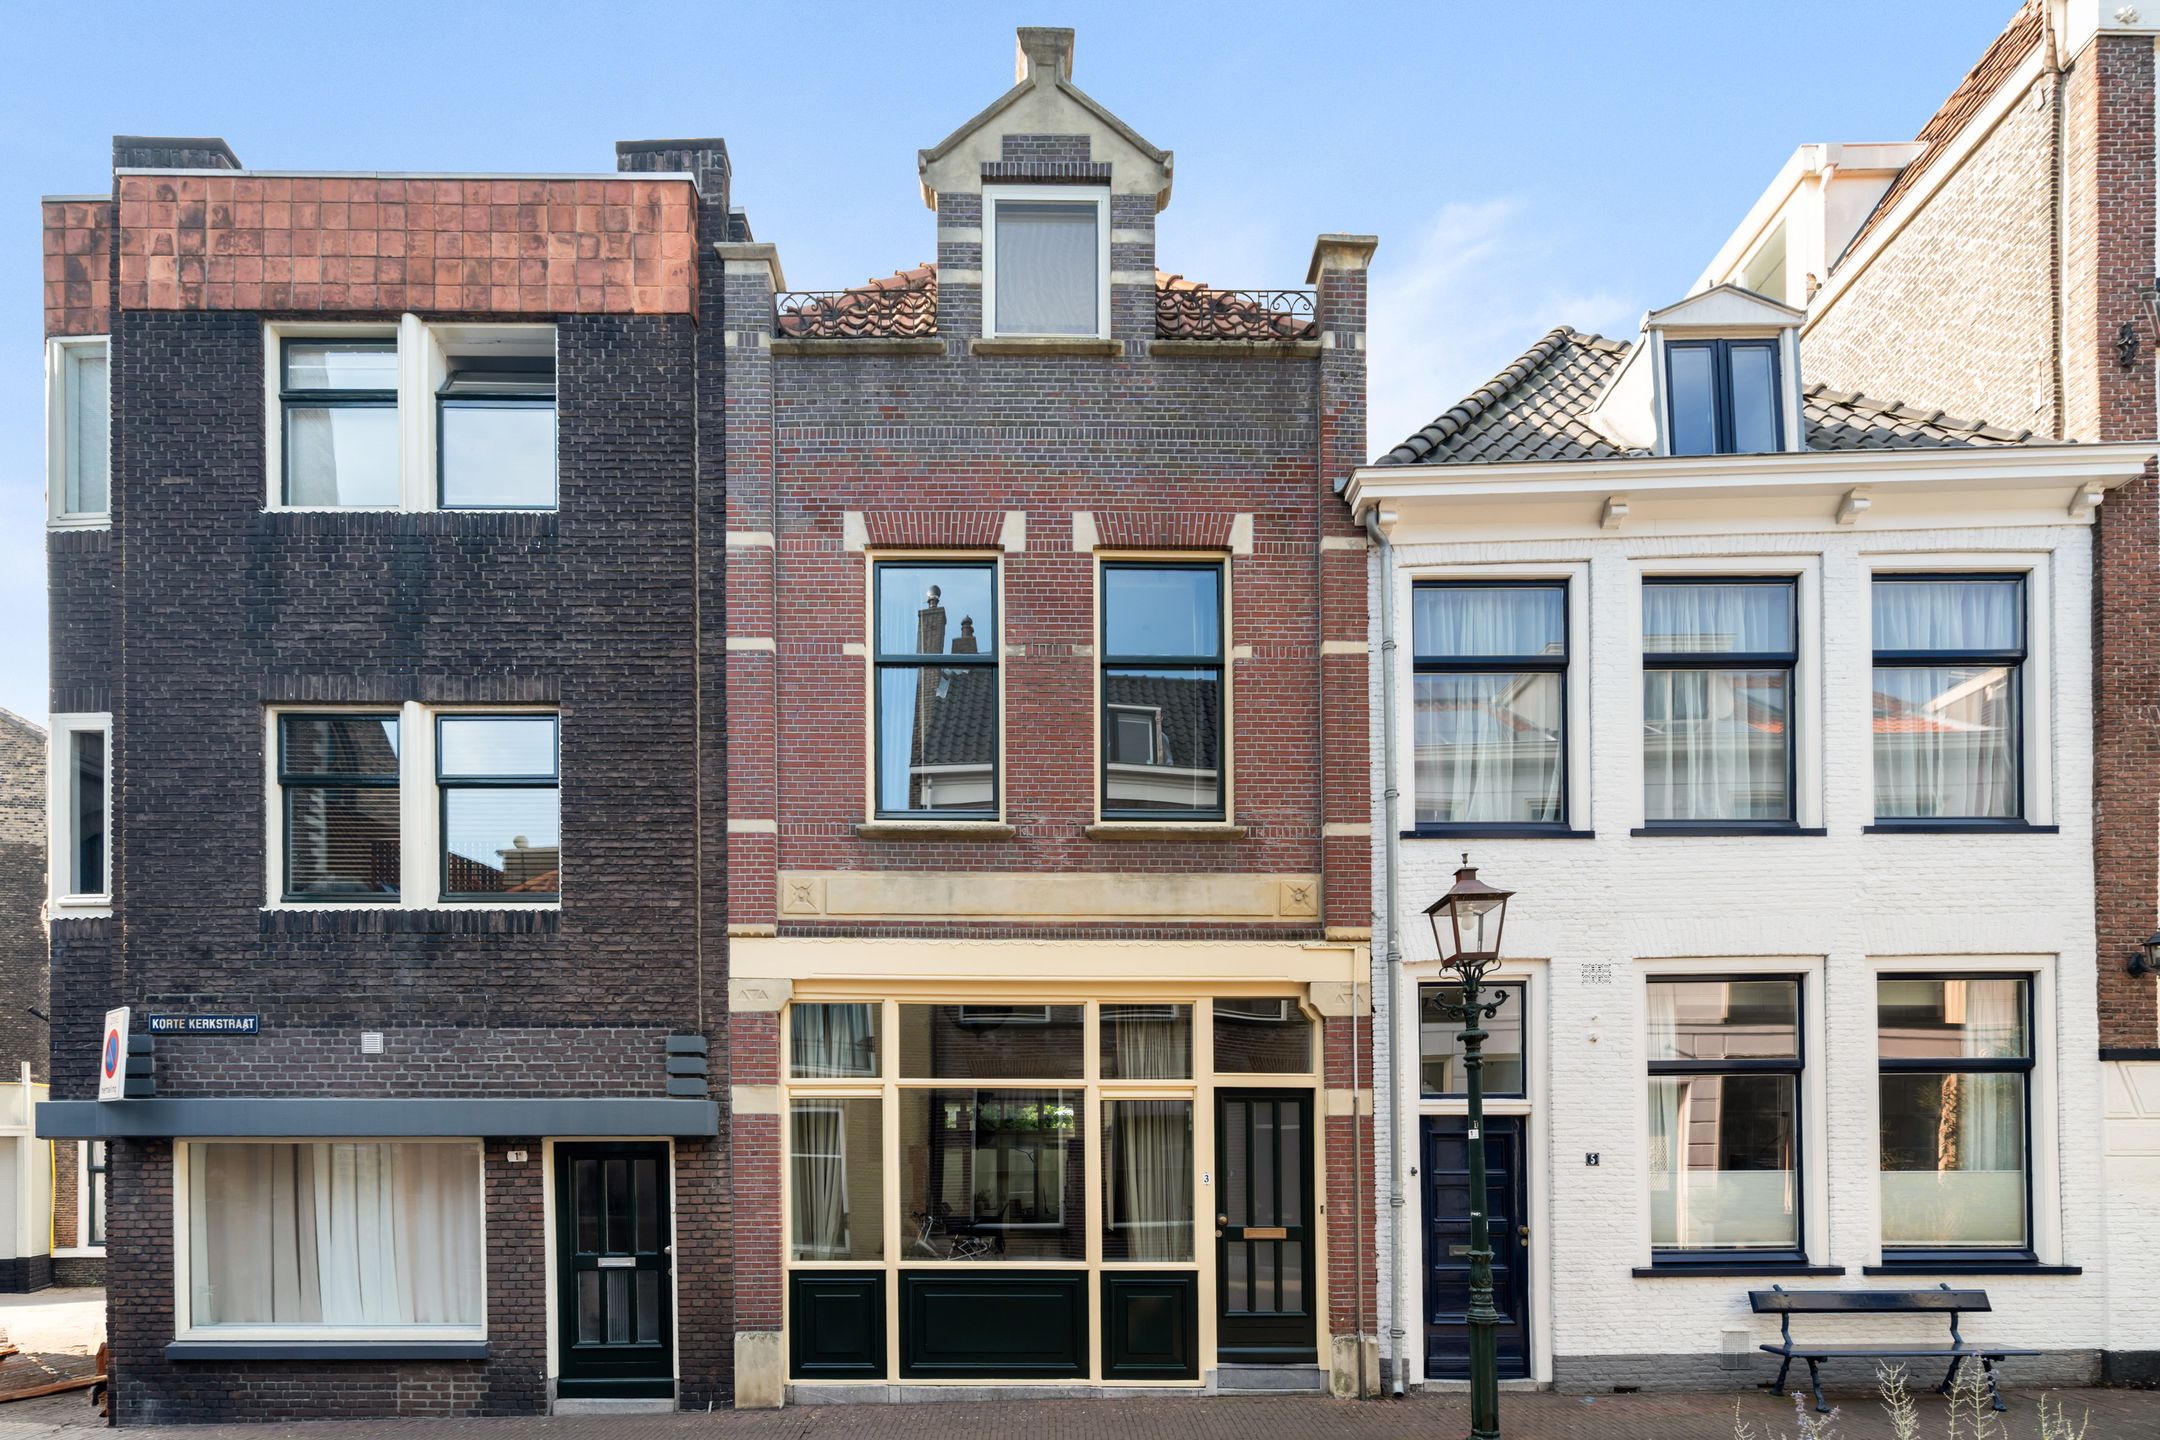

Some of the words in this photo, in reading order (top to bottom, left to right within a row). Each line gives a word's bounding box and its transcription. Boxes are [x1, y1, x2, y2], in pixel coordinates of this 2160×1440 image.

[152, 1018, 186, 1029] KORTE
[188, 1018, 255, 1030] KERKSTRAAT
[1590, 1154, 1596, 1165] 5
[1203, 1174, 1210, 1184] 3
